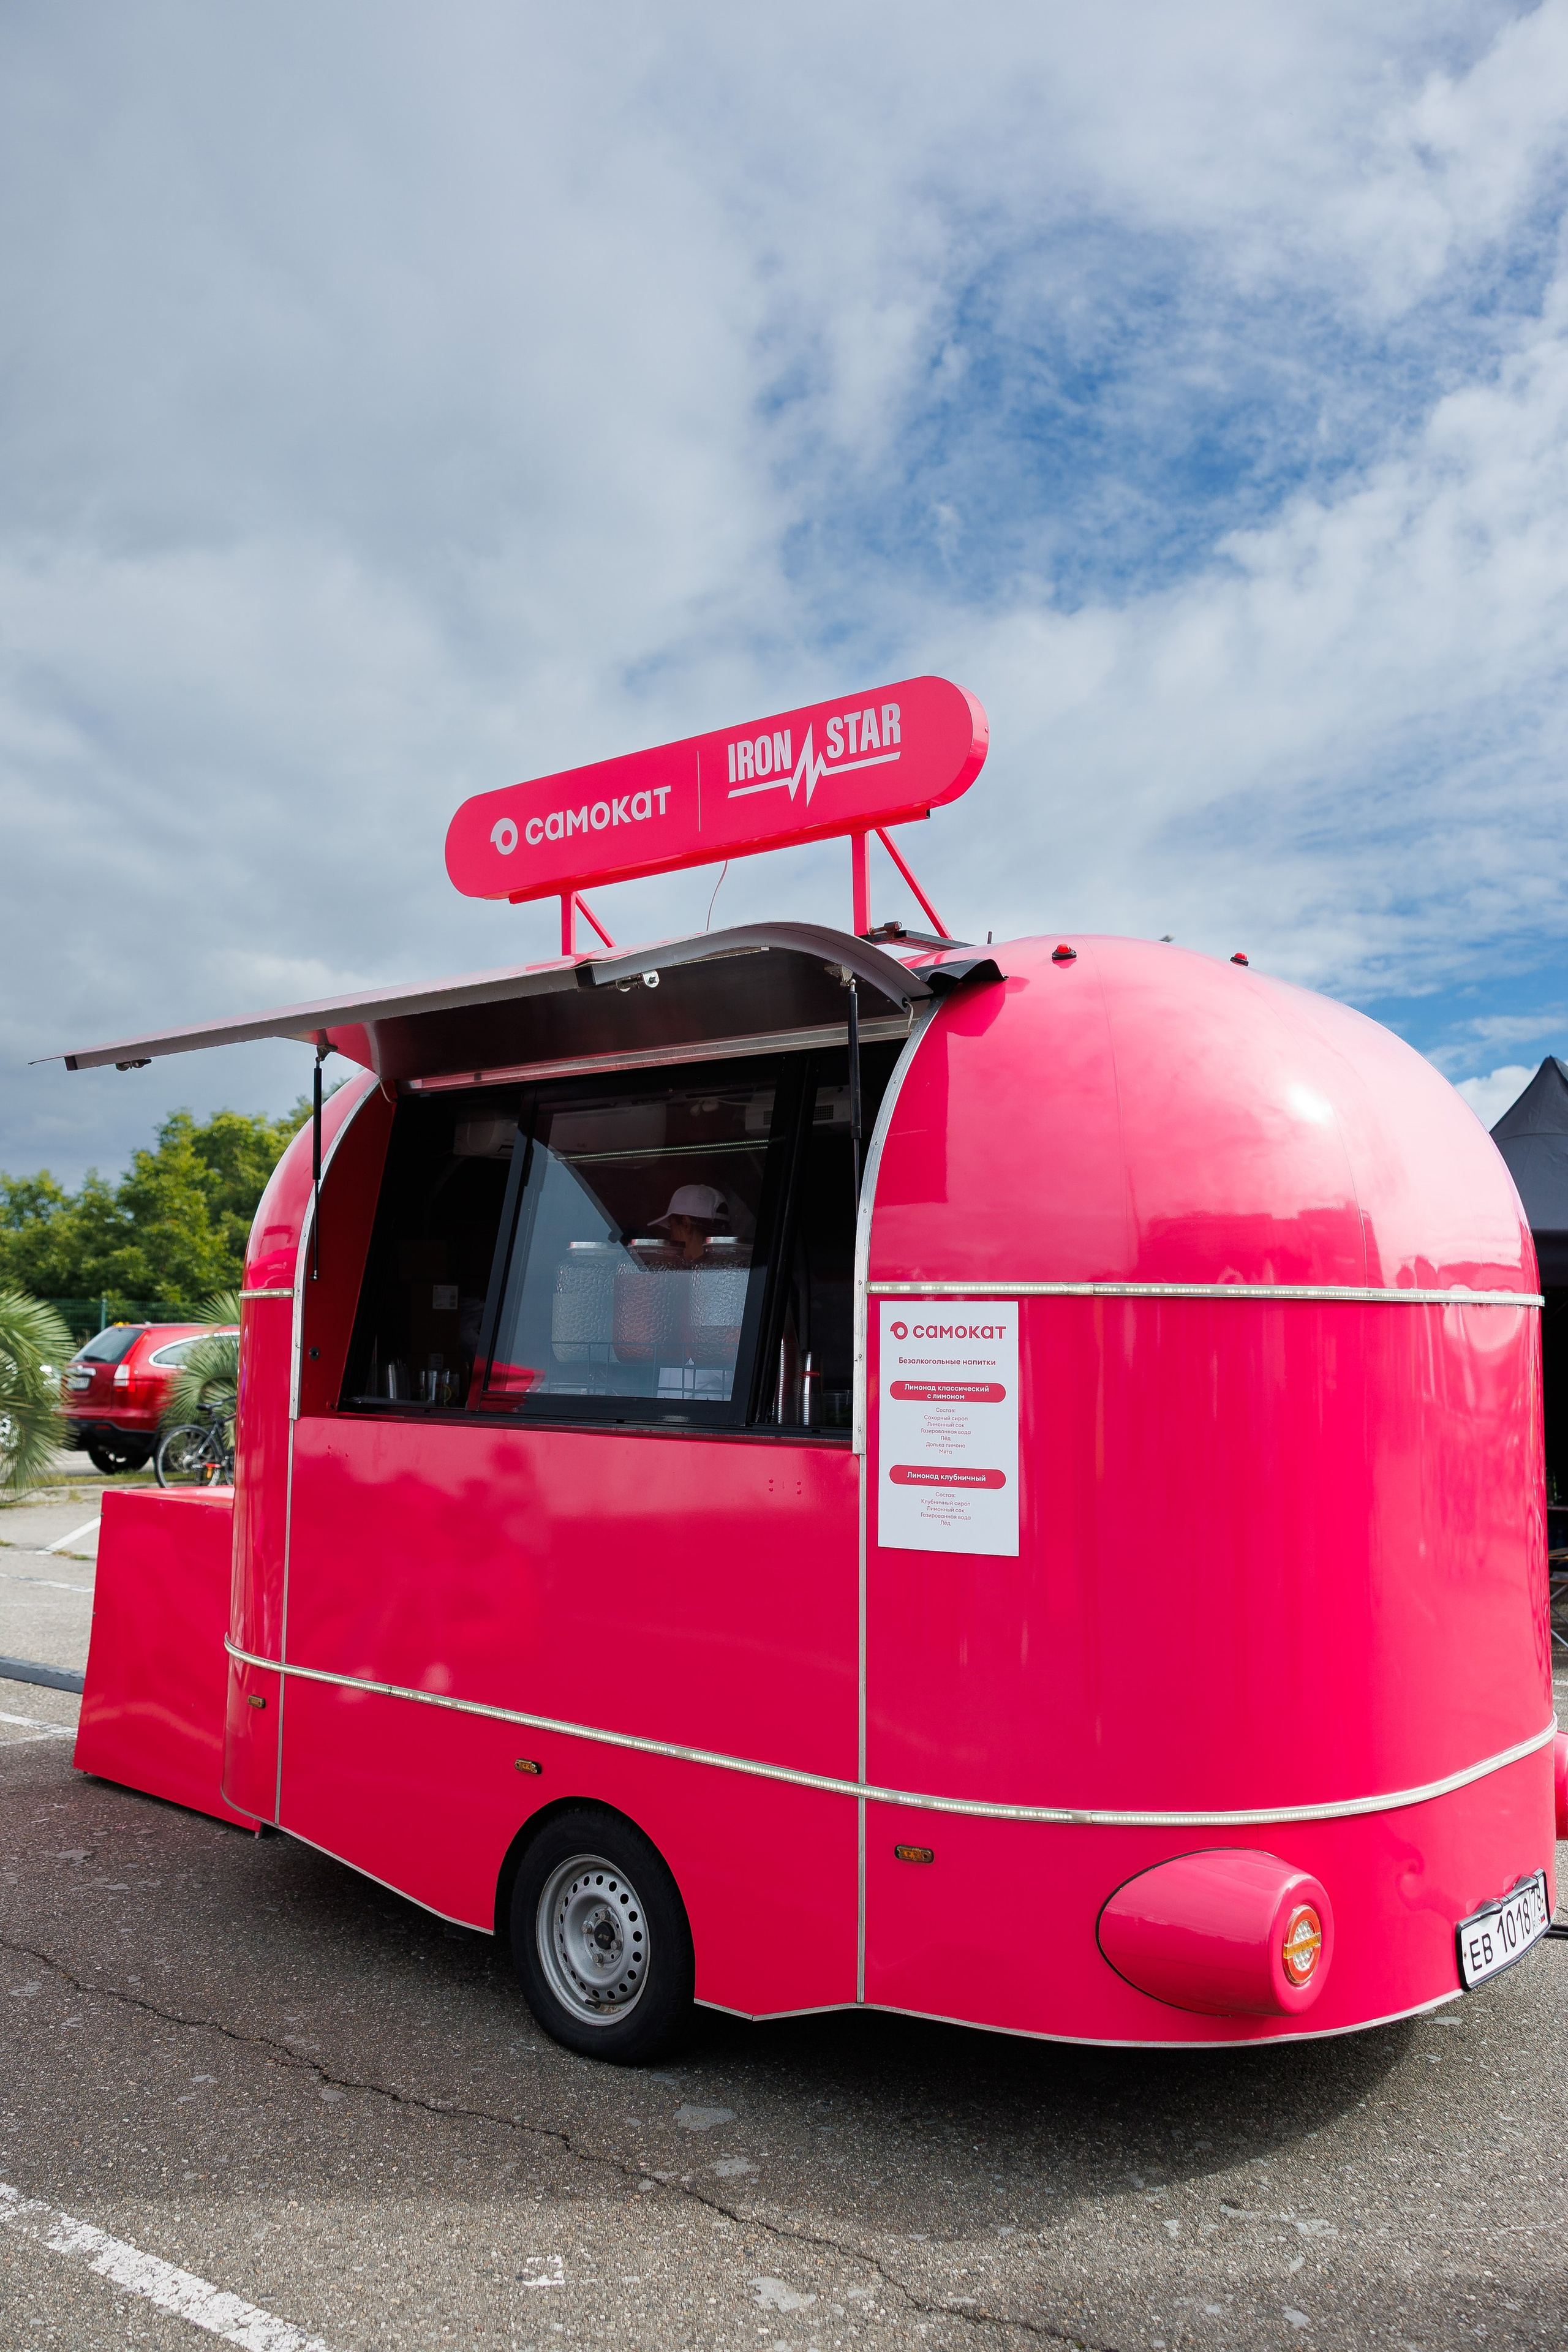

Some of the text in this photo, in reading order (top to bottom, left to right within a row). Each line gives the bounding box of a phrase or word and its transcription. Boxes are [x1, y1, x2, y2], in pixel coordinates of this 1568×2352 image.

[728, 703, 900, 783] IRON STAR
[525, 785, 671, 845] самокат
[913, 1325, 1006, 1339] самокат
[907, 1472, 939, 1480] Лимонад
[1497, 1898, 1531, 1953] 1018
